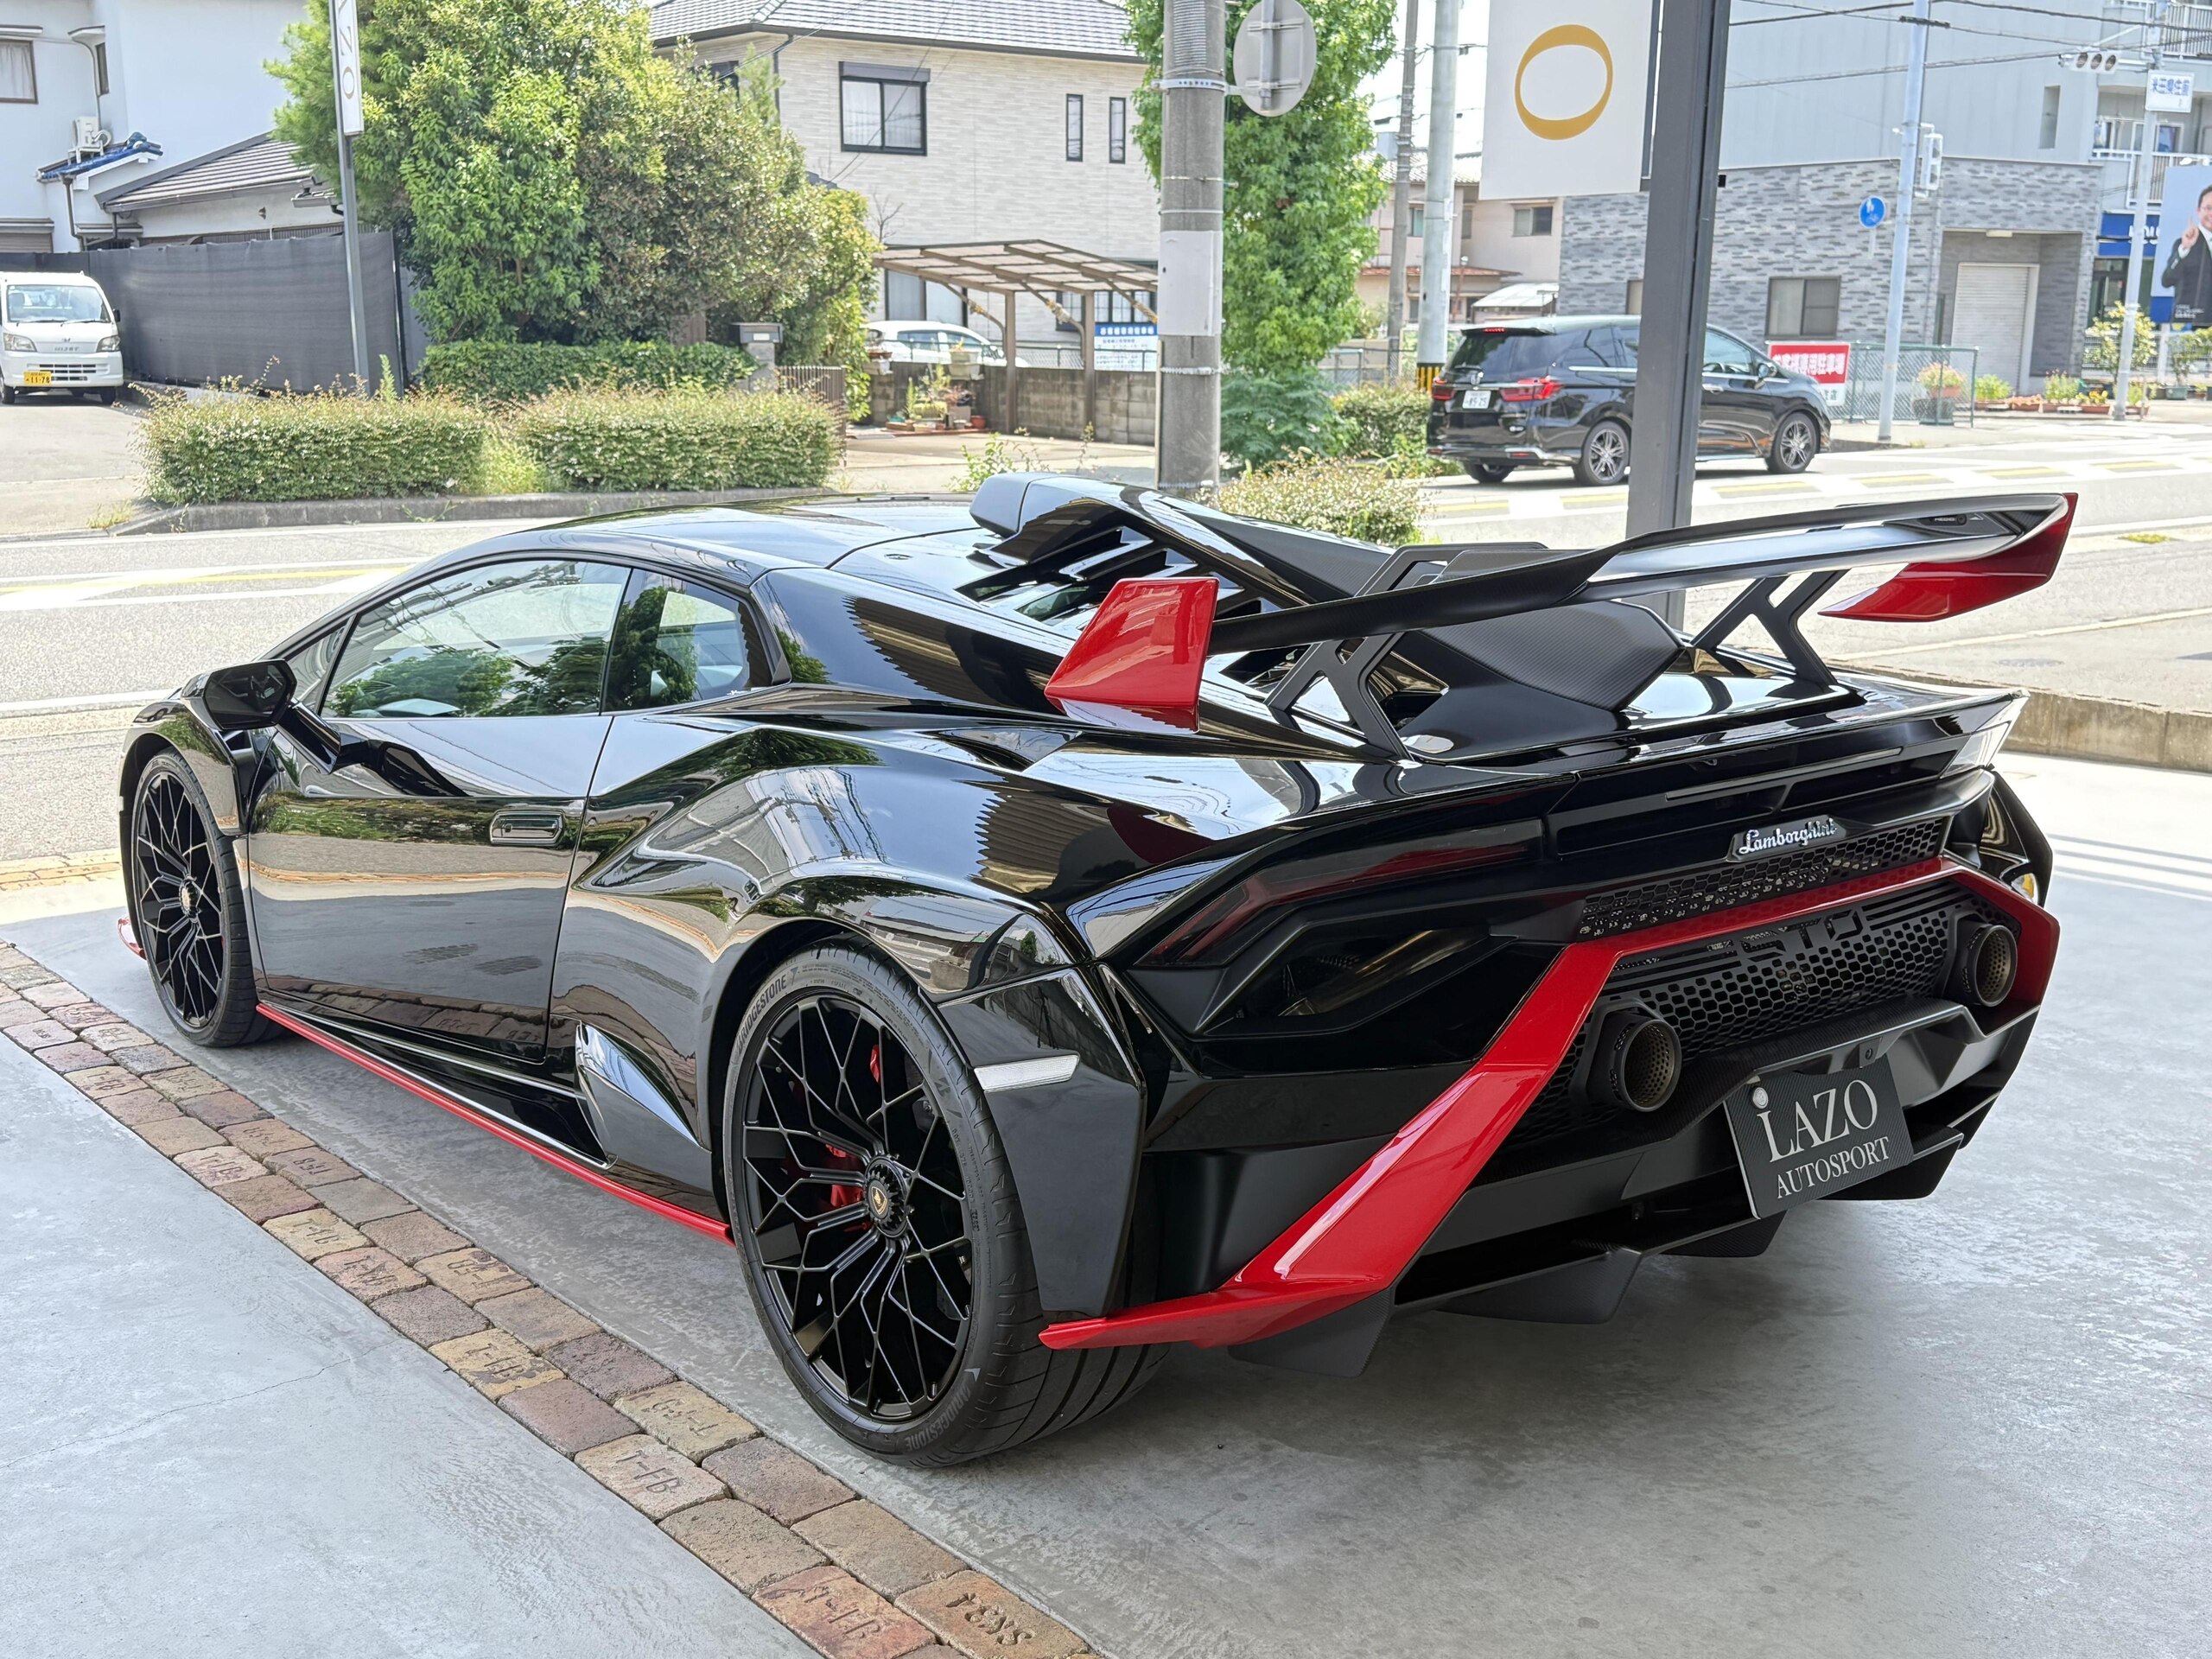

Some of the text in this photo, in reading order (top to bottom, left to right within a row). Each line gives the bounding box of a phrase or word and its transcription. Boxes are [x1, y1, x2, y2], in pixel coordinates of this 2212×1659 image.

[1738, 818, 1838, 854] Lamborghini
[1777, 1136, 1889, 1199] AUTOSPORT
[615, 1450, 683, 1494] T-FB
